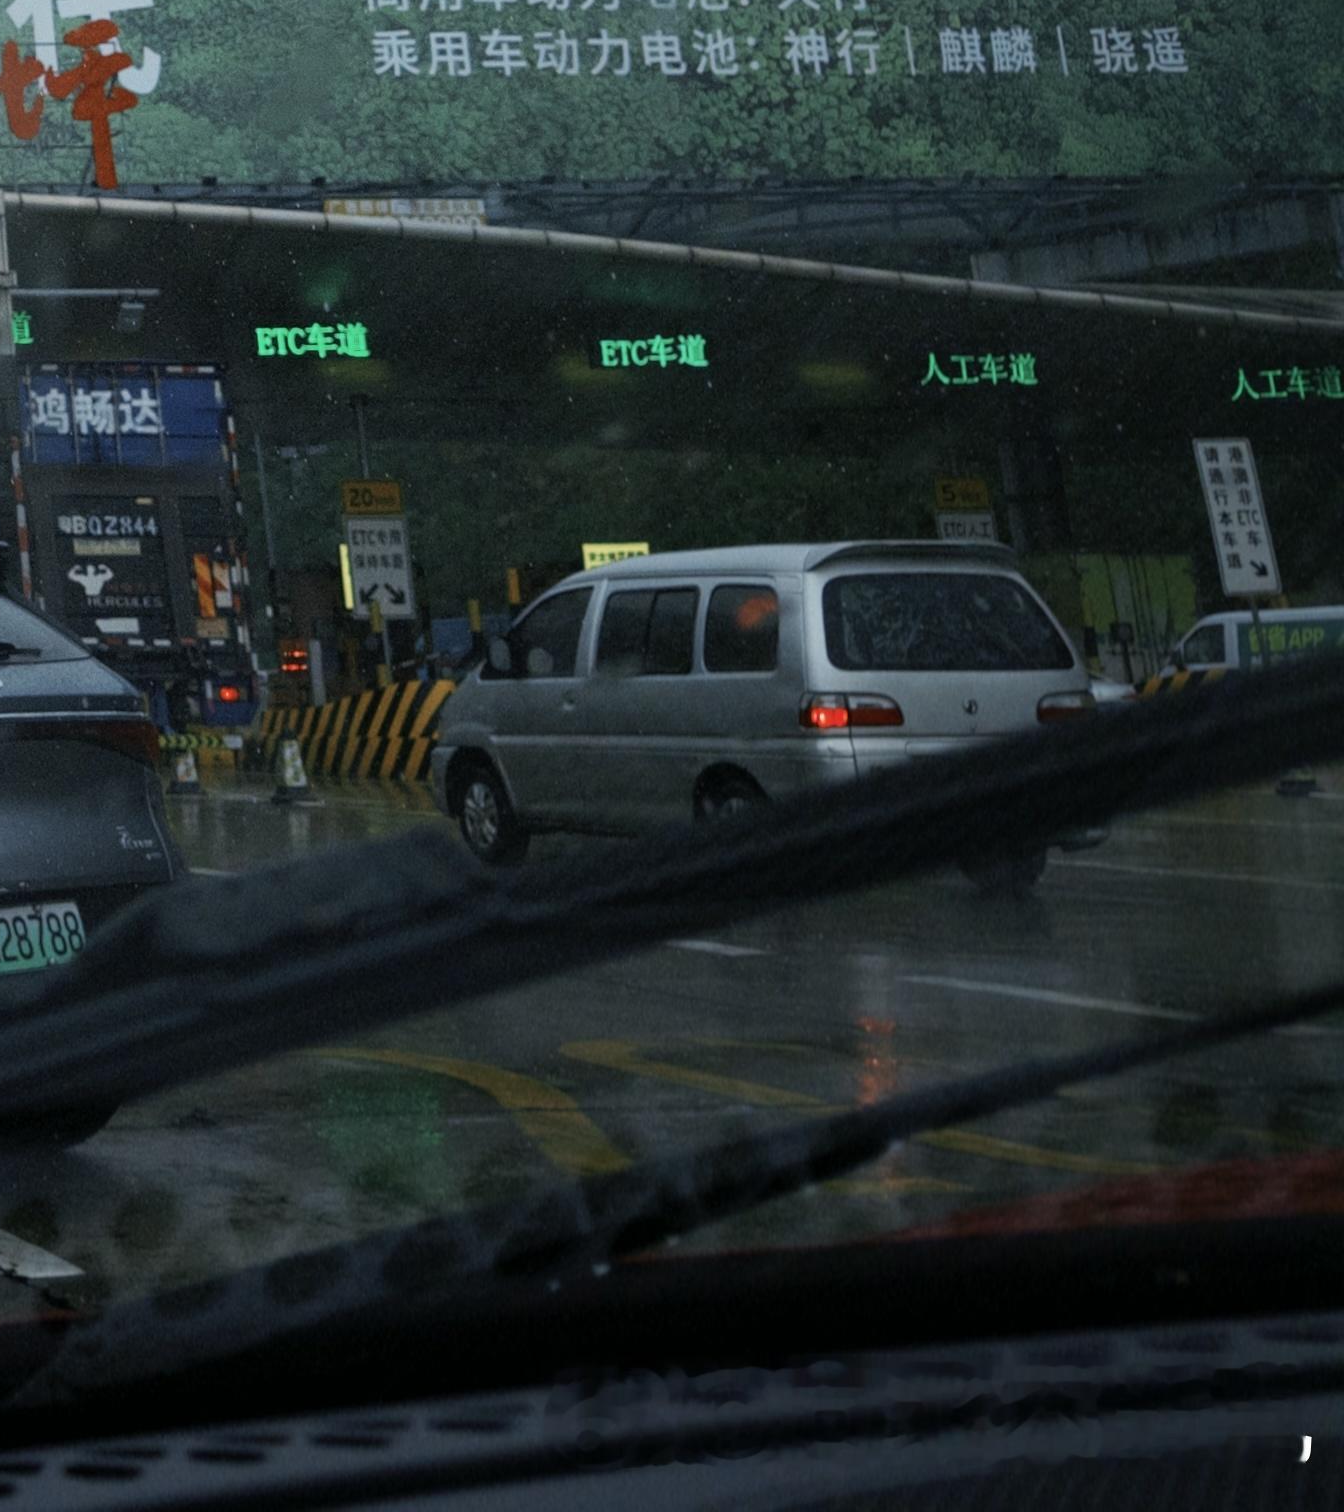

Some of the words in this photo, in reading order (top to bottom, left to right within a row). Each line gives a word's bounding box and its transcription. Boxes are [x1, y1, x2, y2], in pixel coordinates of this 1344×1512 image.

[255, 322, 371, 358] ETC车道
[599, 334, 709, 368] ETC车道
[921, 352, 1039, 386] 人工车道
[29, 388, 165, 435] 鸿畅达
